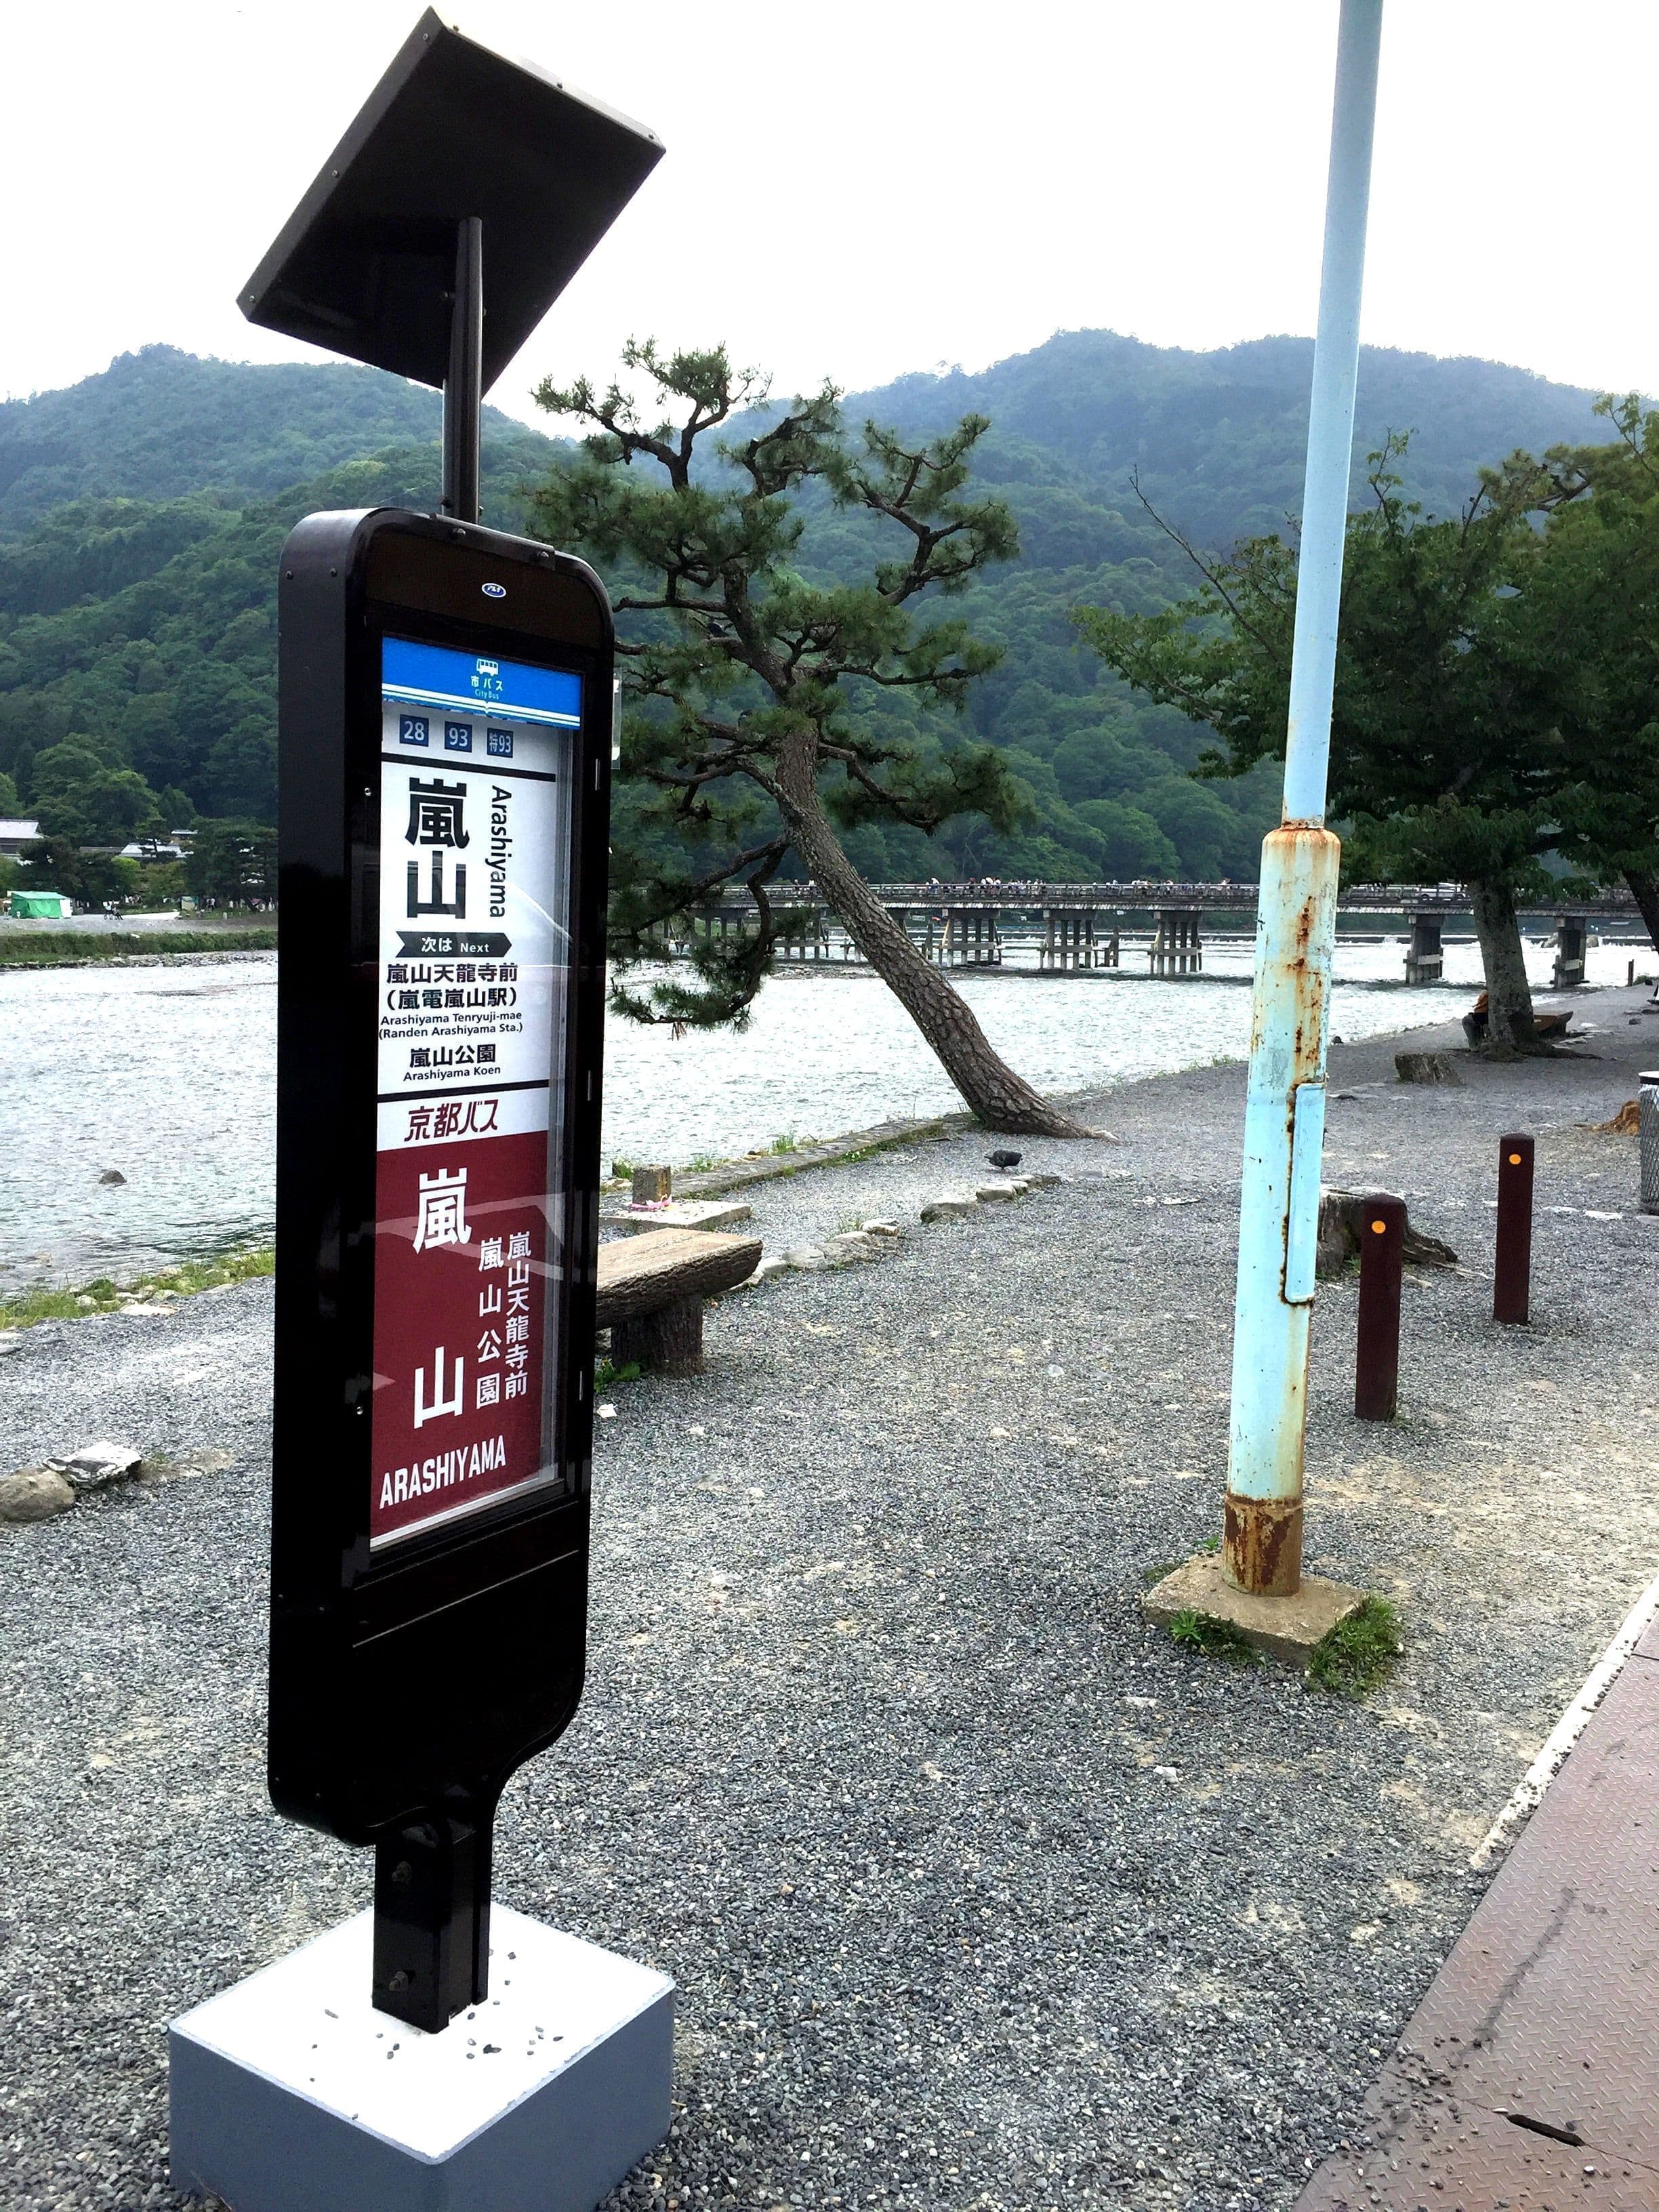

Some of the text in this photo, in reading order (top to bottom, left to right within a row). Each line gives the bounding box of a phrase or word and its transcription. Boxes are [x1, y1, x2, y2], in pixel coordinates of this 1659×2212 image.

[471, 676, 503, 691] 市バス
[404, 720, 425, 741] 28
[449, 727, 468, 747] 93
[405, 777, 470, 919] 嵐山
[485, 785, 512, 918] Arashiyama
[422, 937, 453, 953] 次は
[460, 943, 490, 953] Next
[386, 962, 518, 983] 嵐山天龍寺前
[380, 1011, 523, 1026] Arashiyama Tenryuji-mae
[378, 1022, 523, 1040] (Randen Arashiyama Sta.)
[409, 1044, 497, 1069] 嵐山公園
[403, 1065, 501, 1082] Arashiyama Koen
[404, 1099, 499, 1142] 京都バス
[413, 1167, 472, 1430] 嵐山
[476, 1236, 504, 1410] 嵐山公園
[505, 1231, 532, 1400] 嵐山天龍寺前
[379, 1434, 506, 1510] ARASHIYAMA
